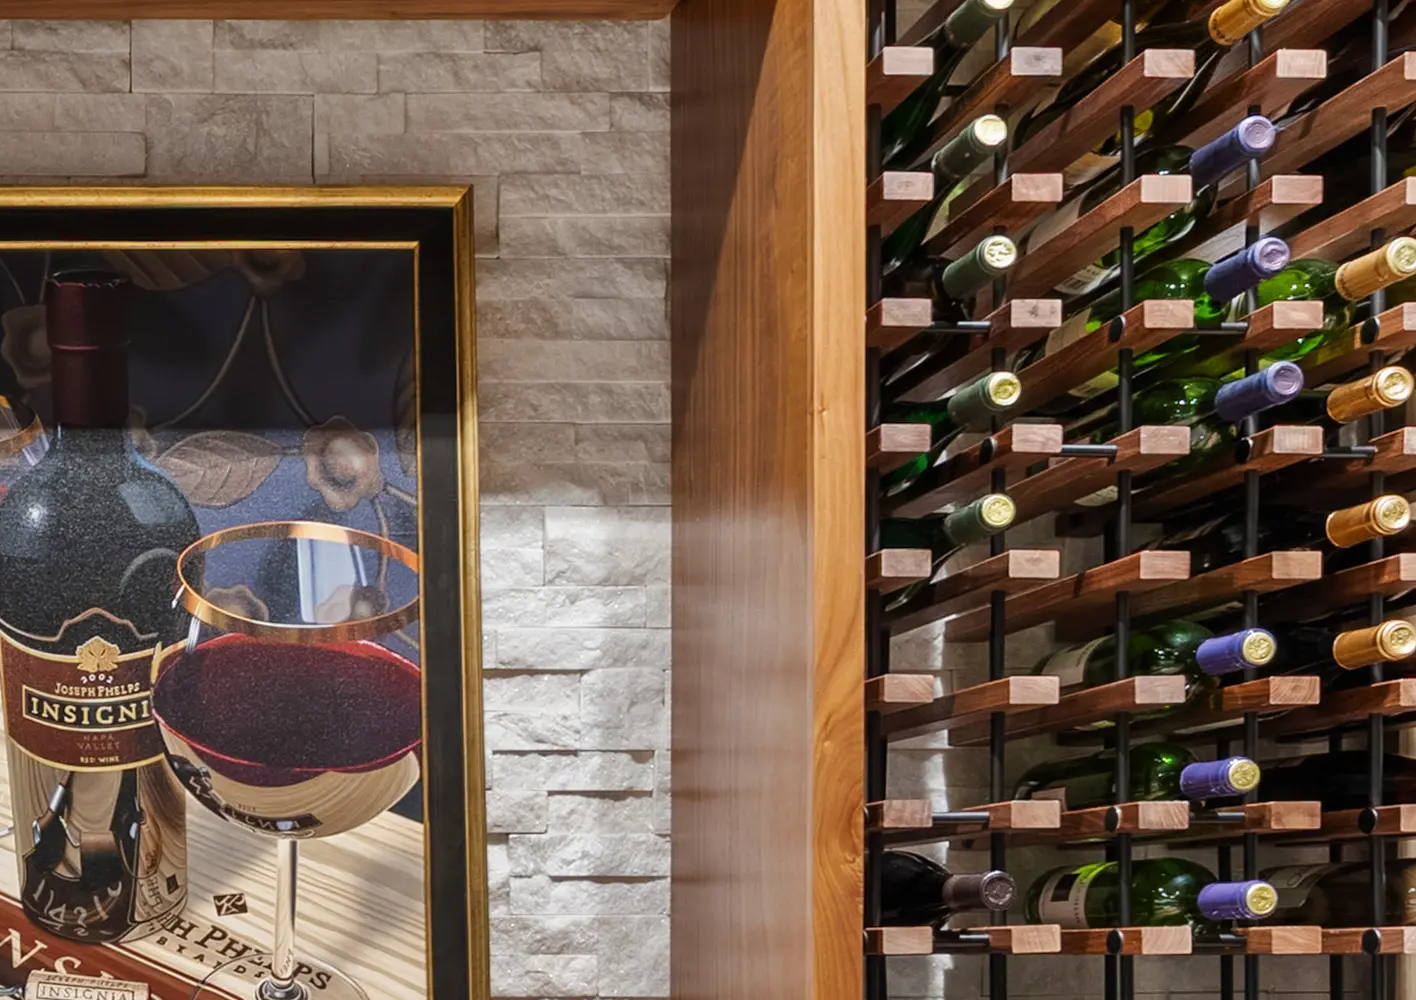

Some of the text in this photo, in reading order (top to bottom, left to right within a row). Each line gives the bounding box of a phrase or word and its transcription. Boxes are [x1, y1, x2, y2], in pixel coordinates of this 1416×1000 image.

[80, 673, 113, 684] 2002
[54, 682, 140, 697] JOSEPH PHELPS
[31, 697, 151, 725] INSIGNI
[84, 734, 114, 742] NAPA
[77, 741, 120, 751] VALLEY
[80, 756, 94, 764] RED
